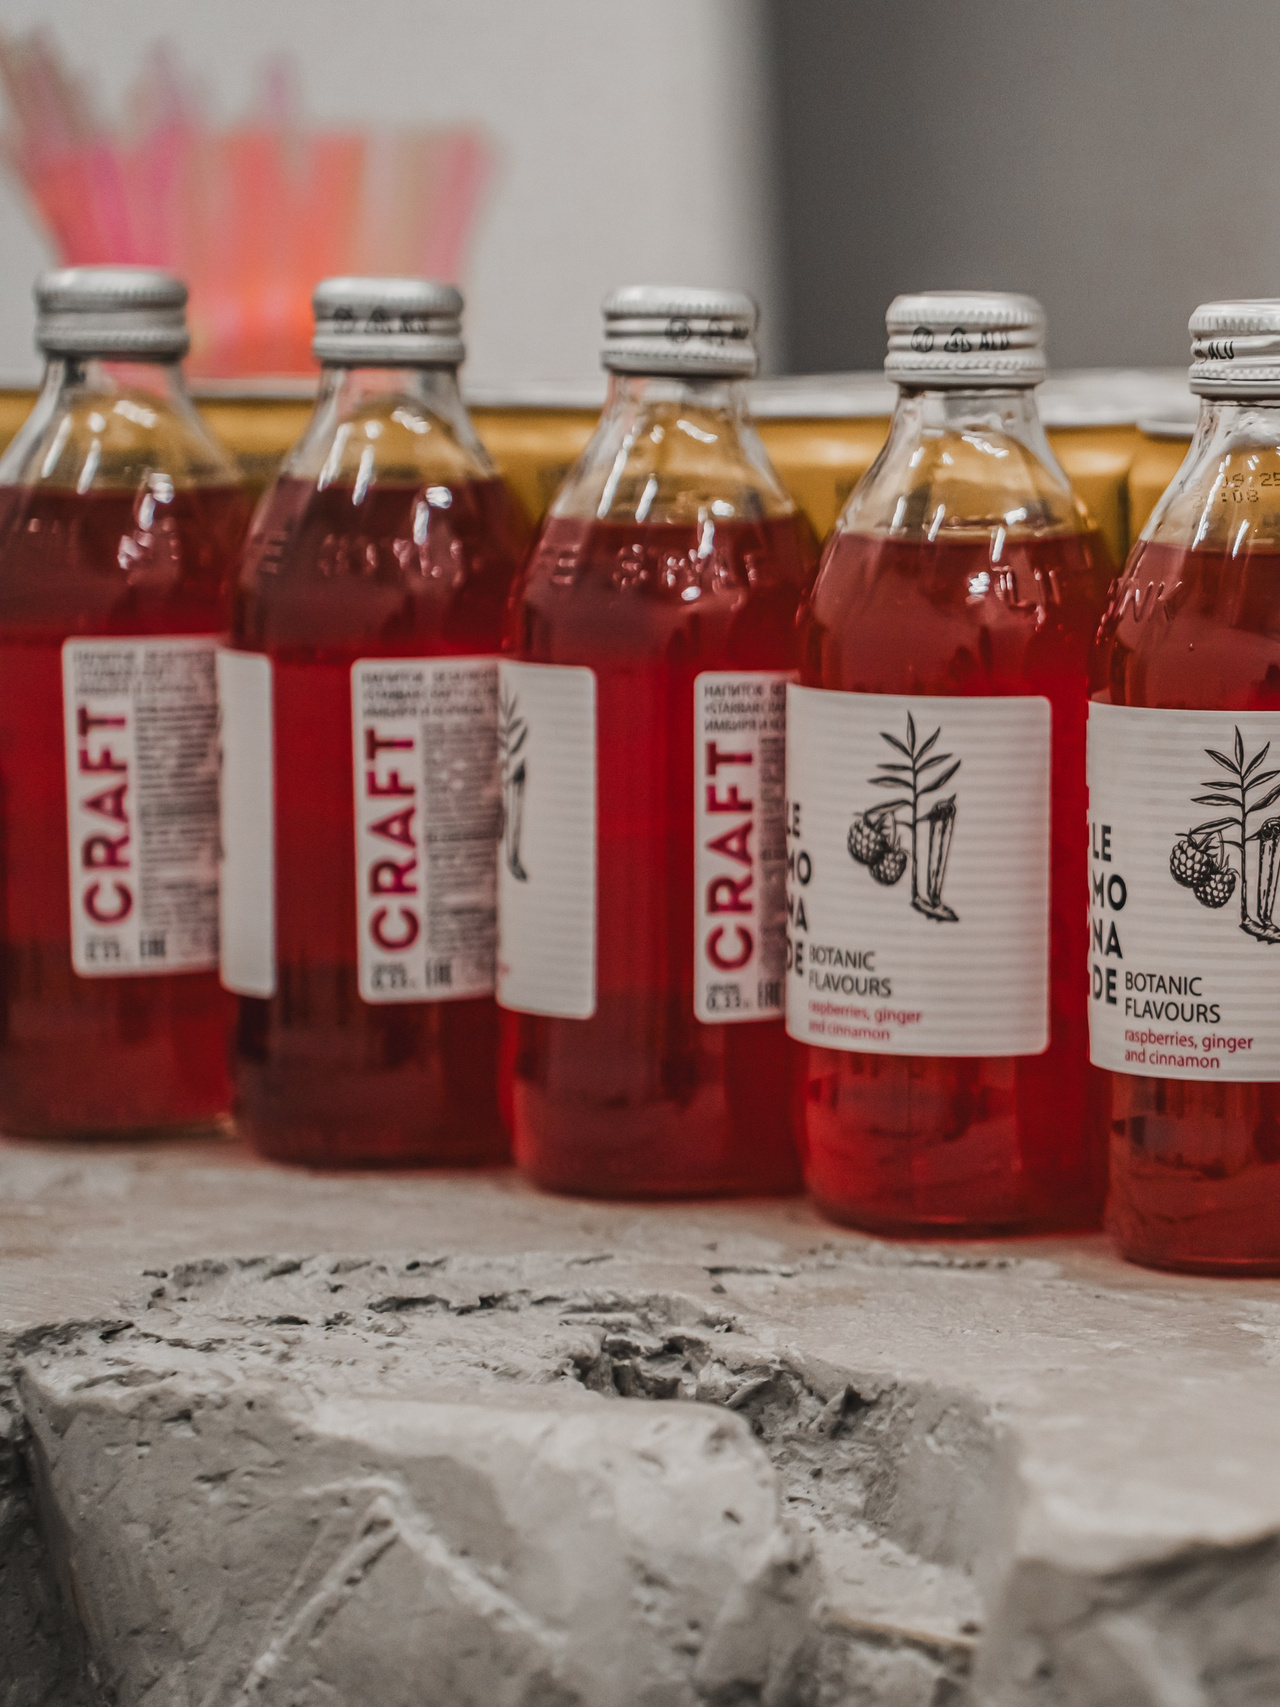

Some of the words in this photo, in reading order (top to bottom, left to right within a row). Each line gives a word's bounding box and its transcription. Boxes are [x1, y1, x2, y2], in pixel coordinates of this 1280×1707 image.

[1208, 341, 1234, 360] ALU
[77, 705, 133, 926] CRAFT
[364, 727, 420, 952] CRAFT
[706, 741, 754, 973] CRAFT
[1092, 822, 1111, 863] LE
[1092, 870, 1127, 911] MO
[1092, 918, 1123, 959] NA
[809, 969, 892, 998] FLAVOURS
[1093, 963, 1117, 1005] DE
[1125, 971, 1202, 996] BOTANIC
[874, 1008, 921, 1026] ginger
[1125, 998, 1220, 1024] FLAVOURS
[1125, 1029, 1198, 1050] raspberries,
[1202, 1035, 1253, 1053] ginger
[1125, 1050, 1146, 1063] and
[1149, 1050, 1220, 1069] cinnamon
